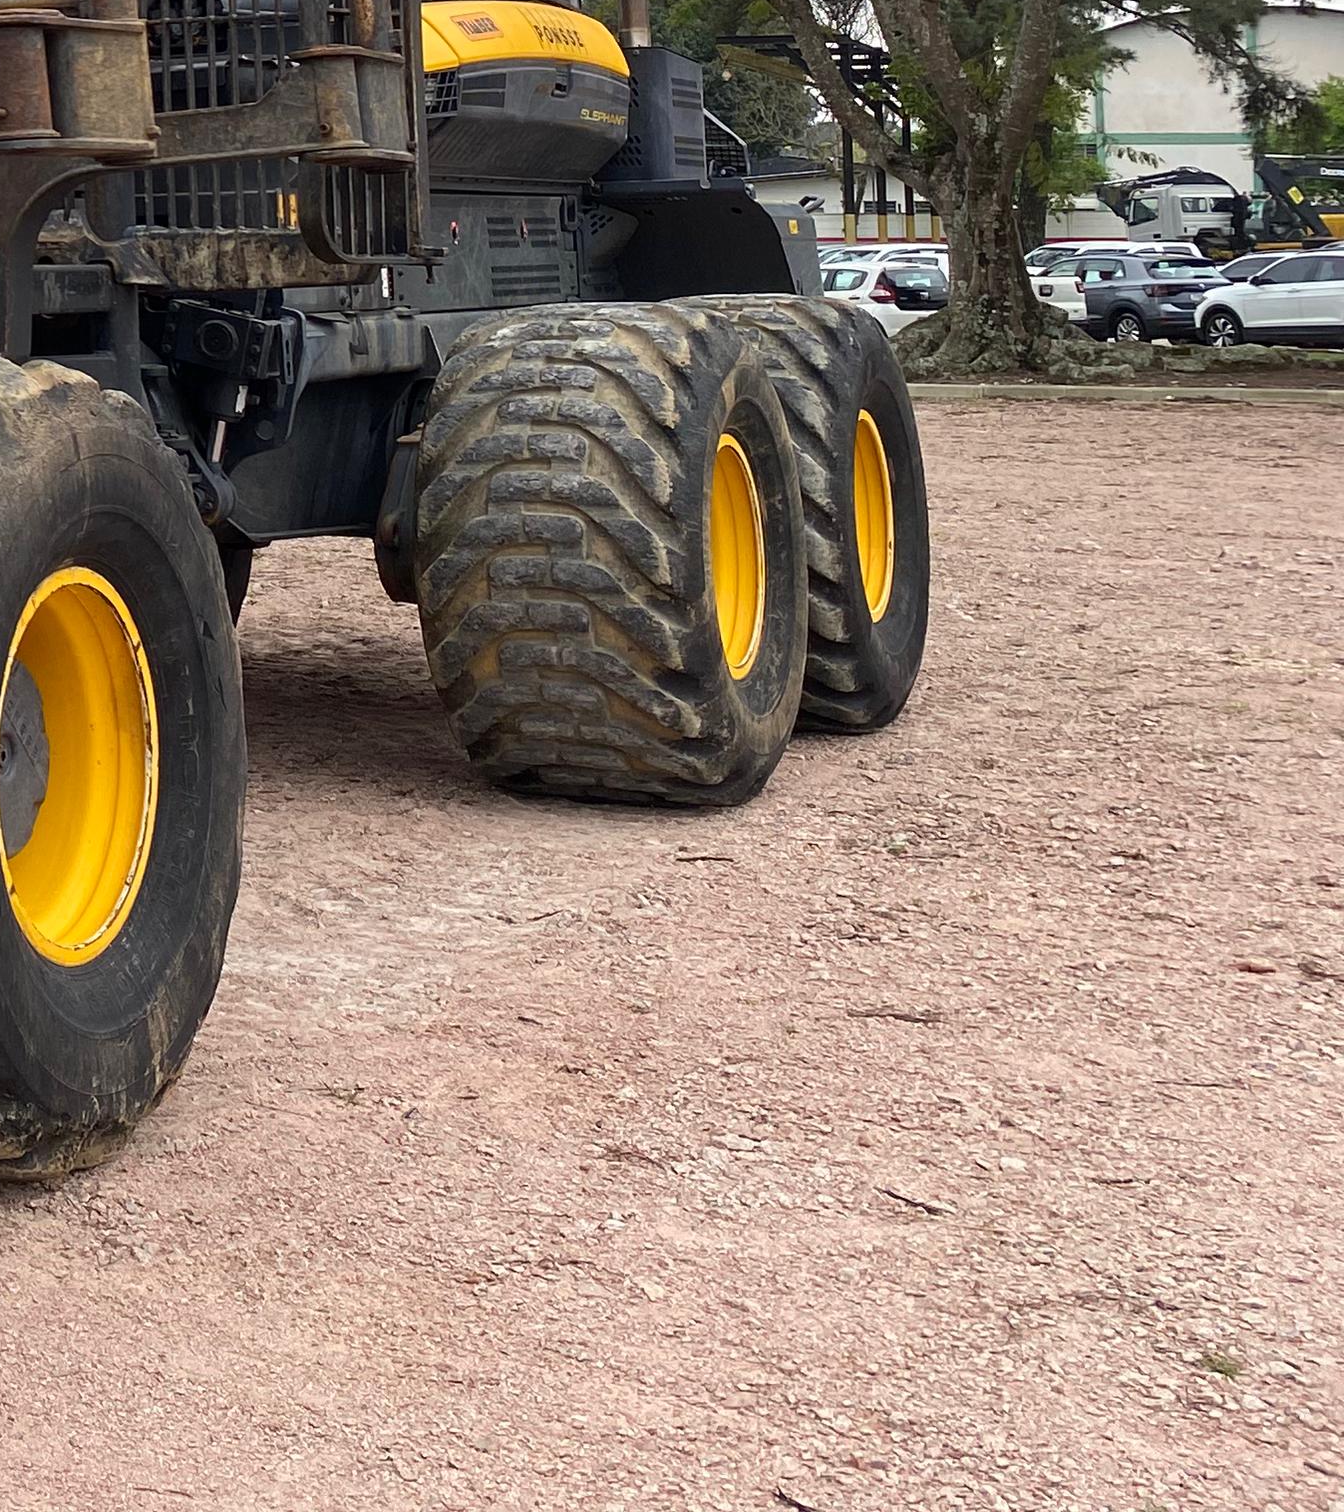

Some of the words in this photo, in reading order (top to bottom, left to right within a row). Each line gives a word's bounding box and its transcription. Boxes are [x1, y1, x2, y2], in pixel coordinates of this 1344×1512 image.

[457, 16, 500, 36] TIMBER
[533, 24, 585, 48] PONSSE
[579, 107, 628, 126] ELEPHANT
